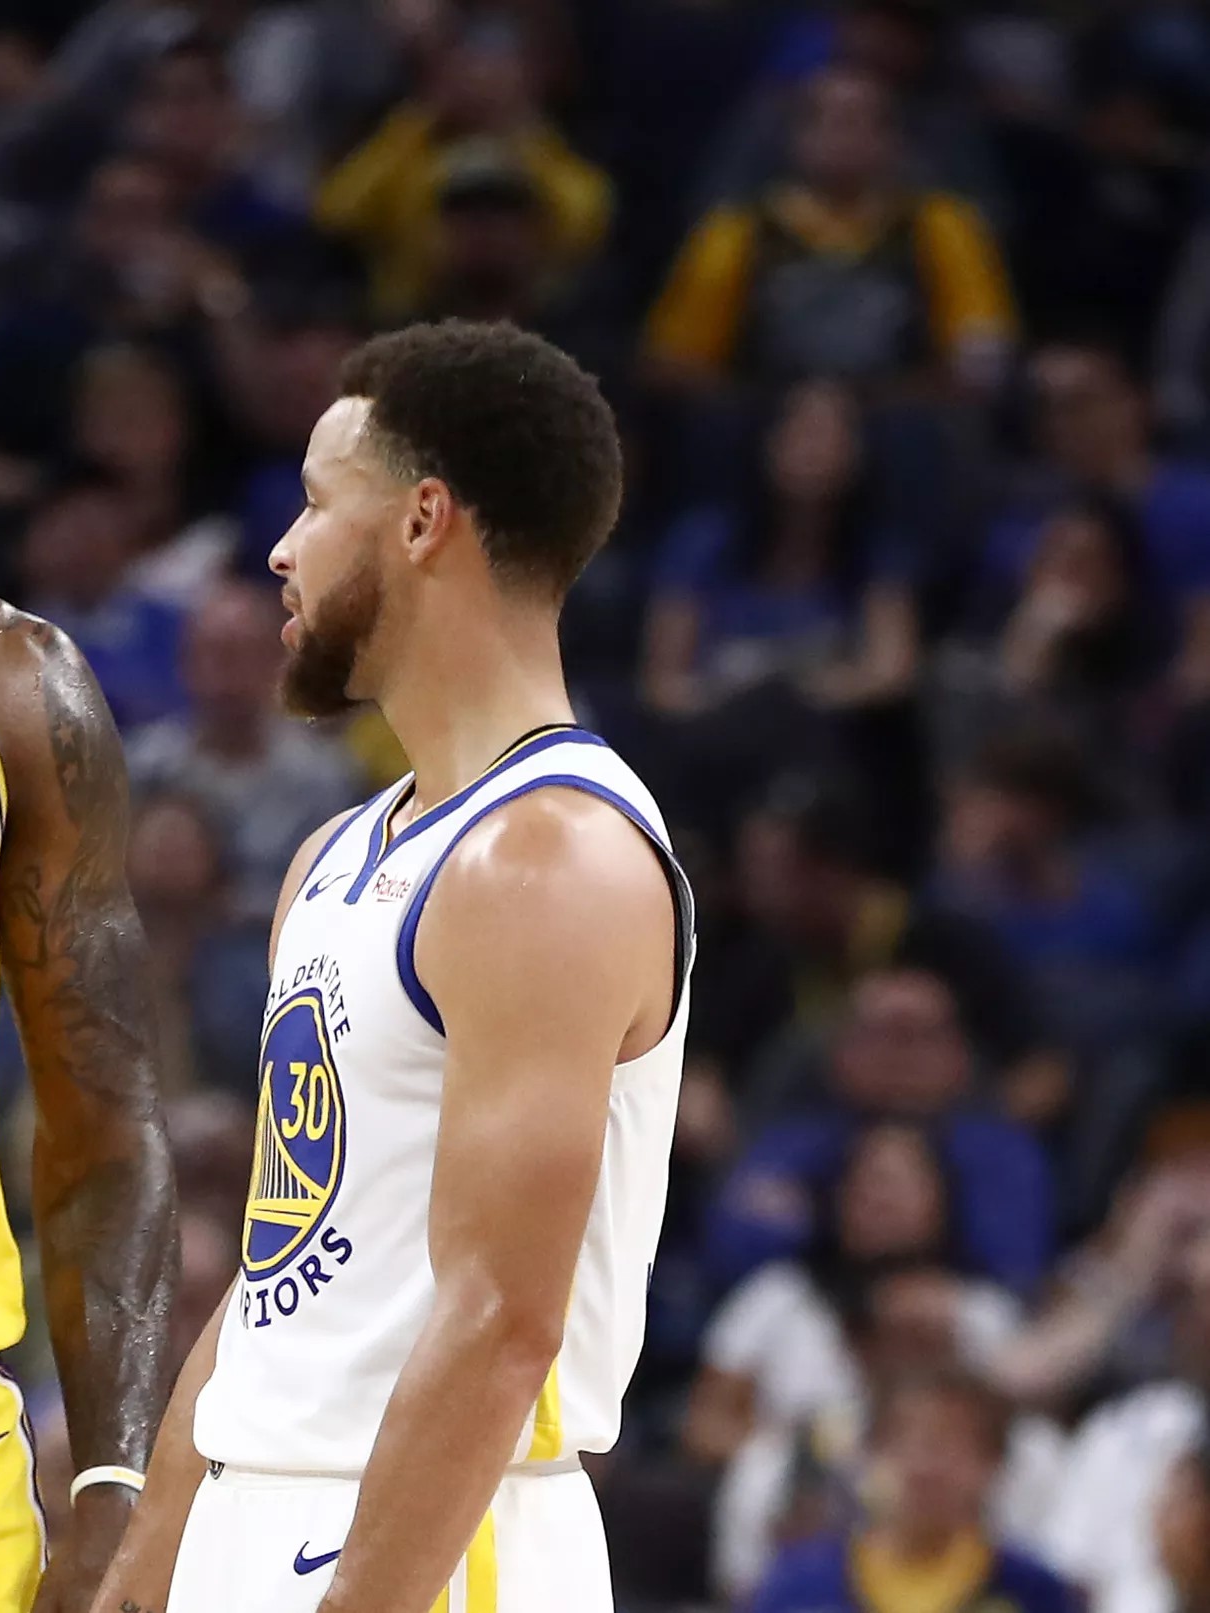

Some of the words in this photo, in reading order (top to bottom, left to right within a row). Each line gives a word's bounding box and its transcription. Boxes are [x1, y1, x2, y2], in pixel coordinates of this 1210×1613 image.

[265, 954, 329, 1016] OLDEN
[325, 960, 351, 1043] STATE
[281, 1062, 330, 1141] 30
[240, 1226, 353, 1330] RIORS
